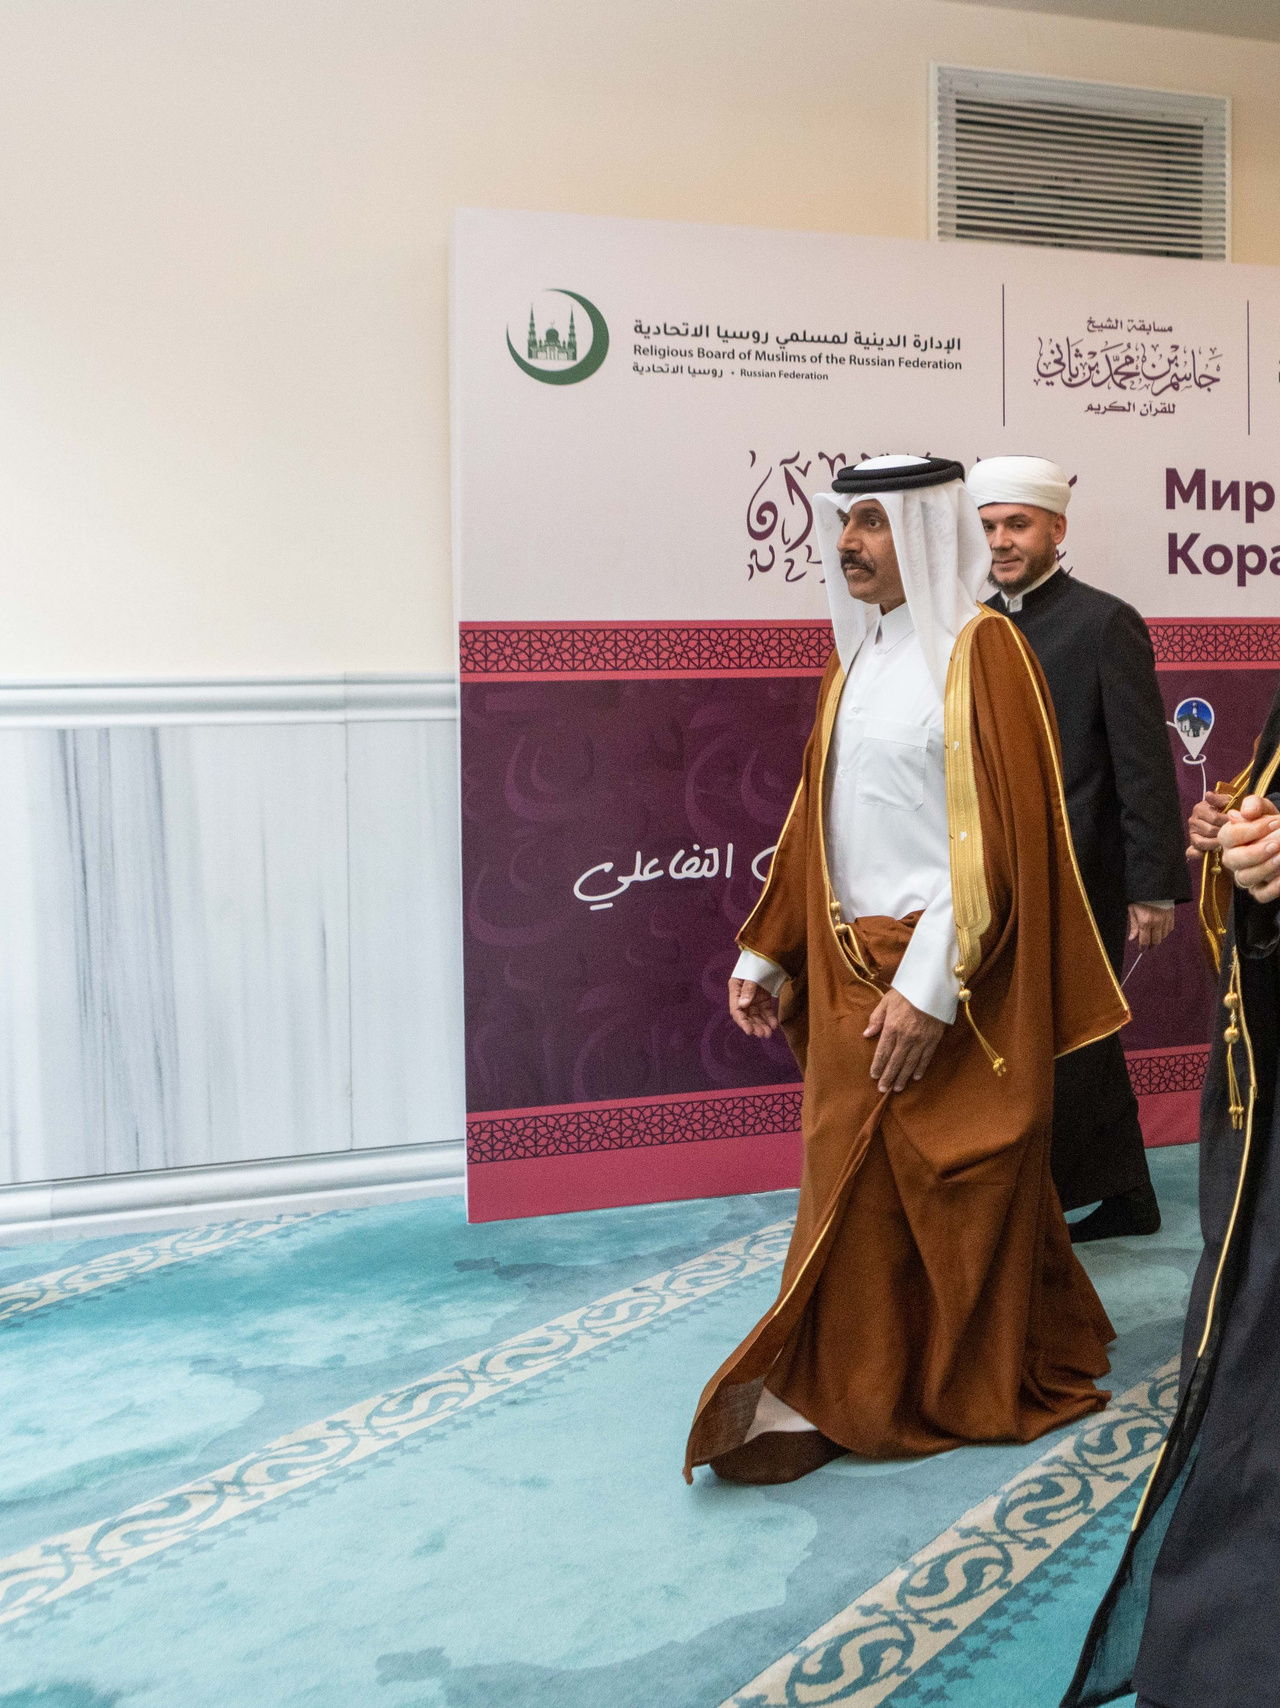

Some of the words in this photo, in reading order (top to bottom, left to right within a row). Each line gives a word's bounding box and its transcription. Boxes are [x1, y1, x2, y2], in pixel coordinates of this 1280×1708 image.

[633, 319, 710, 339] الاتحادية
[1086, 316, 1123, 333] الشيخ
[1127, 318, 1173, 335] مسابقة
[716, 324, 769, 344] روسيا
[776, 329, 848, 350] لمسلمي
[853, 331, 907, 351] الدينية
[913, 334, 961, 354] الإدارة
[633, 344, 694, 359] Religious
[697, 347, 735, 360] Board
[738, 349, 752, 361] of
[755, 350, 807, 363] Muslims
[810, 352, 823, 364] of
[825, 352, 846, 365] the
[849, 354, 895, 367] Russian
[898, 357, 963, 370] Federation
[632, 361, 684, 376] الاتحادية
[687, 365, 724, 378] روسيا
[740, 368, 776, 379] Russian
[779, 369, 829, 381] Federation
[1084, 401, 1136, 415] الكريم
[1139, 401, 1176, 417] للقرآن
[1165, 467, 1276, 524] Мир
